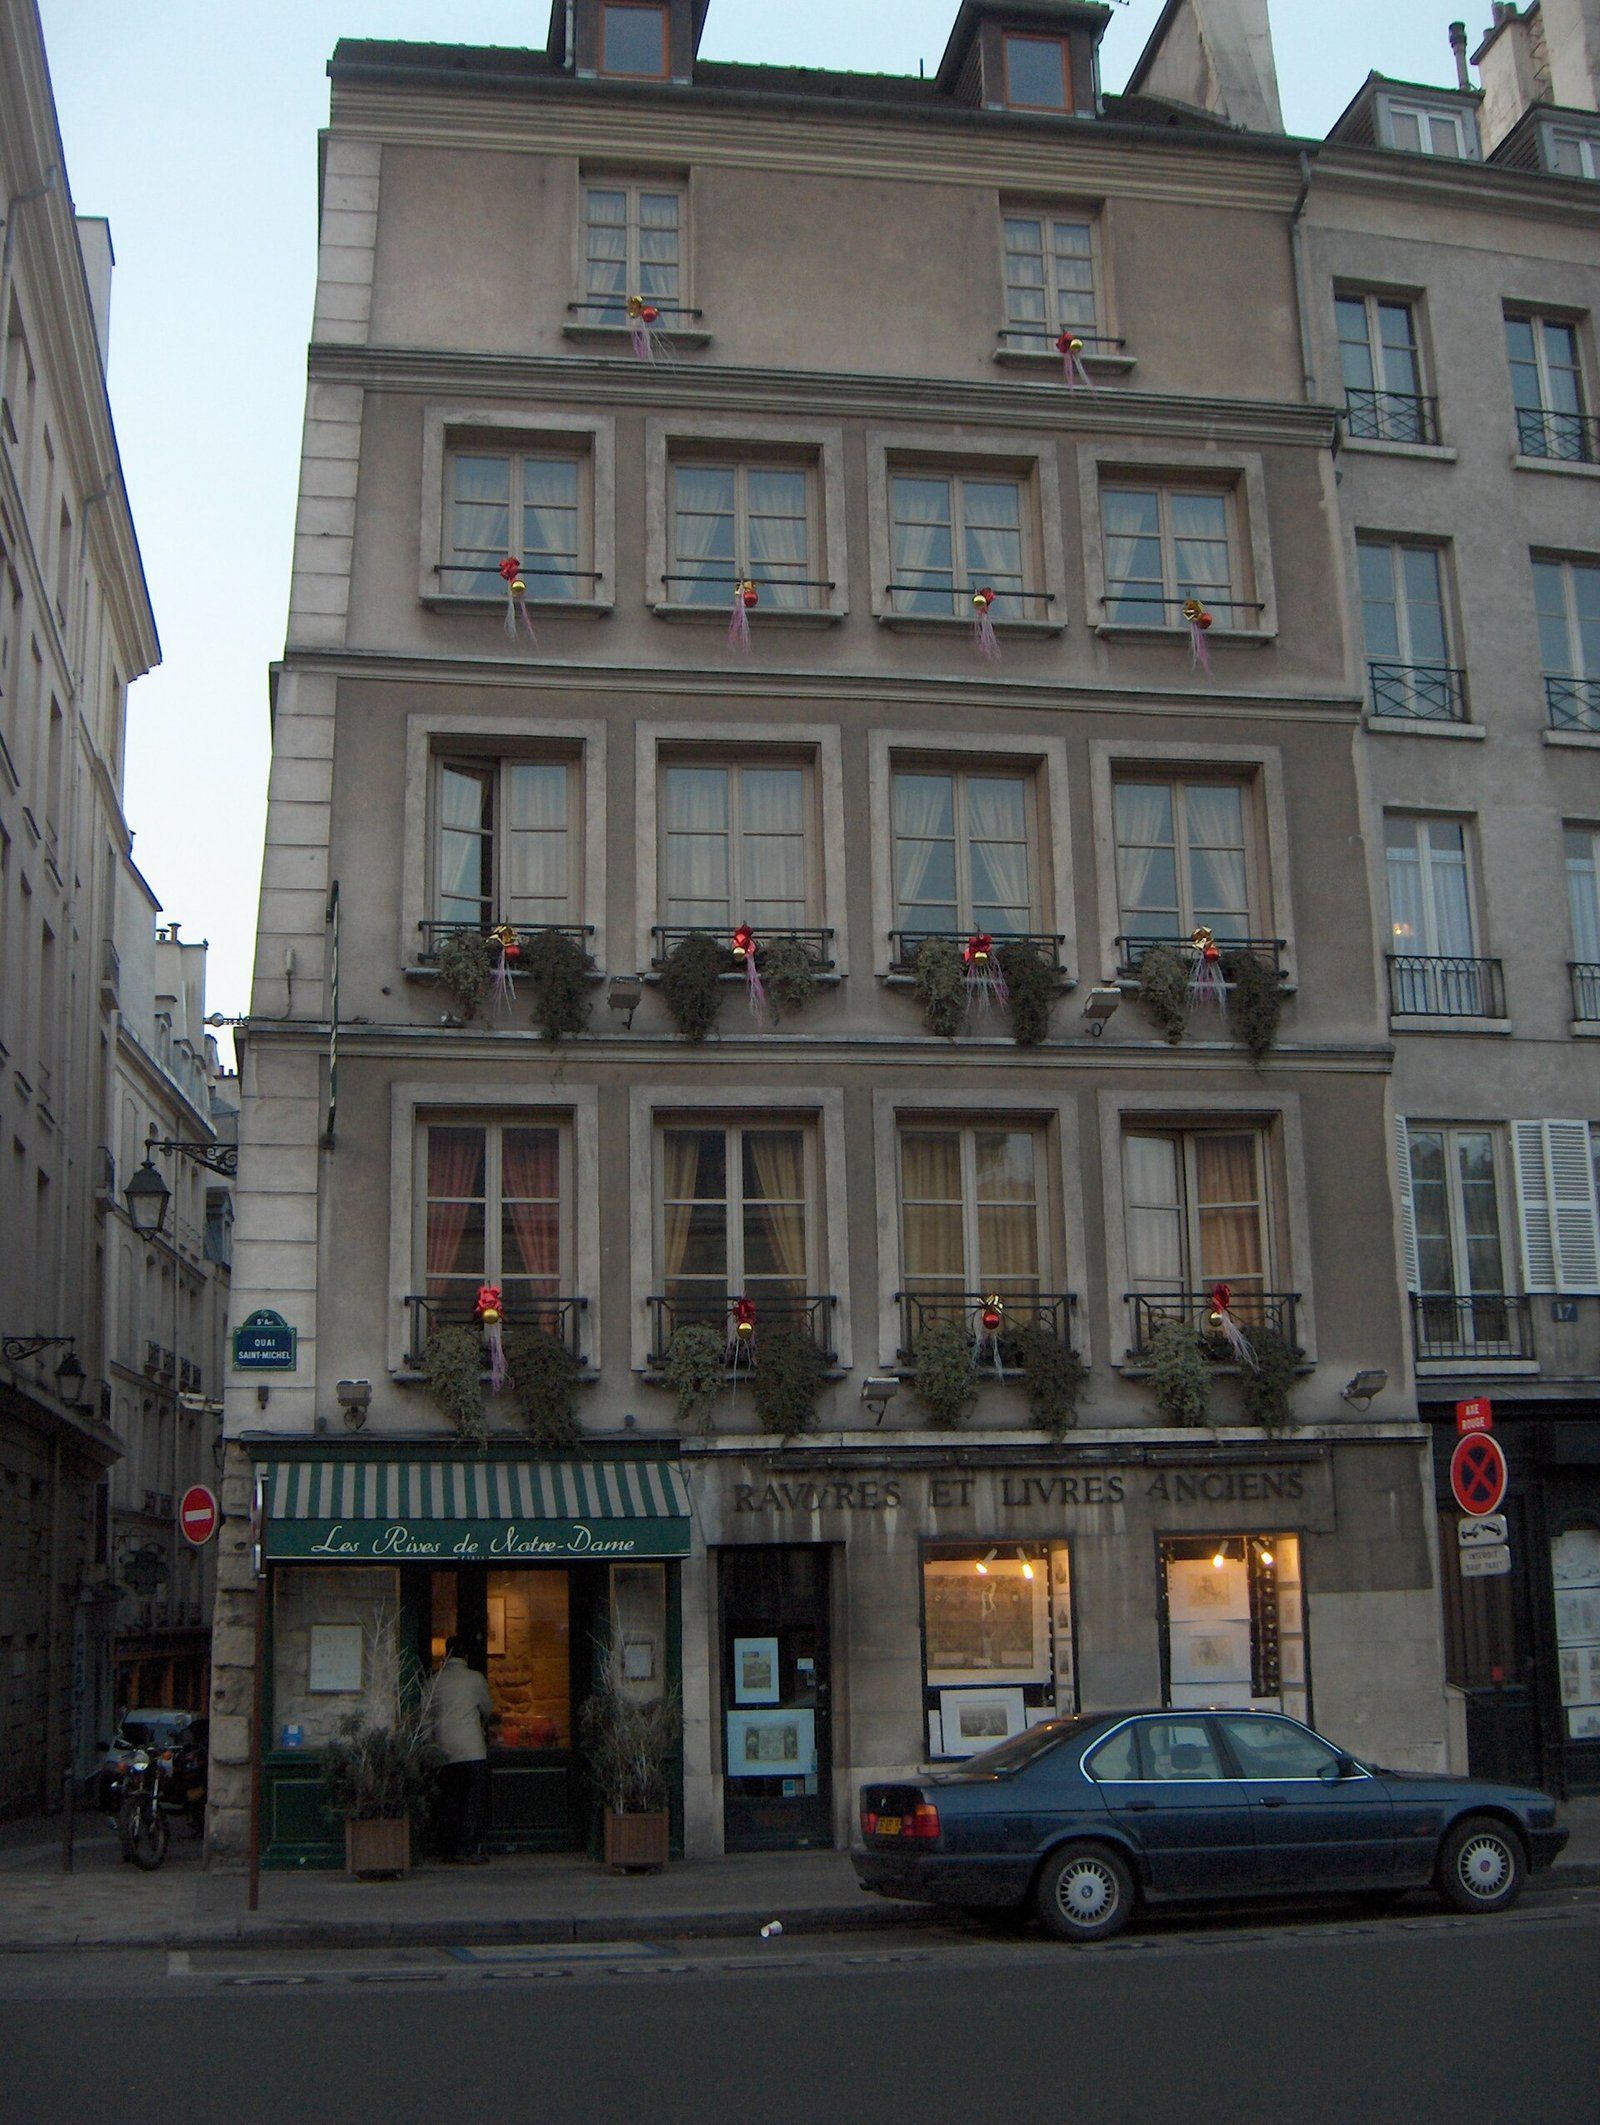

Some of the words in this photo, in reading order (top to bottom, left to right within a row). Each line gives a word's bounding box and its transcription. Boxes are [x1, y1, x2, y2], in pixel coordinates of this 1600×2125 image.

[253, 1338, 277, 1348] QUAI
[238, 1350, 291, 1360] SAINT-MICHEL
[1465, 1403, 1480, 1416] AXE
[1461, 1416, 1485, 1430] ROUGE
[930, 1478, 976, 1508] ET
[1002, 1475, 1125, 1506] LIVRES
[1145, 1470, 1307, 1500] ANCIENS
[310, 1525, 360, 1553] Les
[372, 1525, 441, 1554] Rives
[452, 1533, 479, 1553] de
[490, 1525, 635, 1553] Notre-Dame
